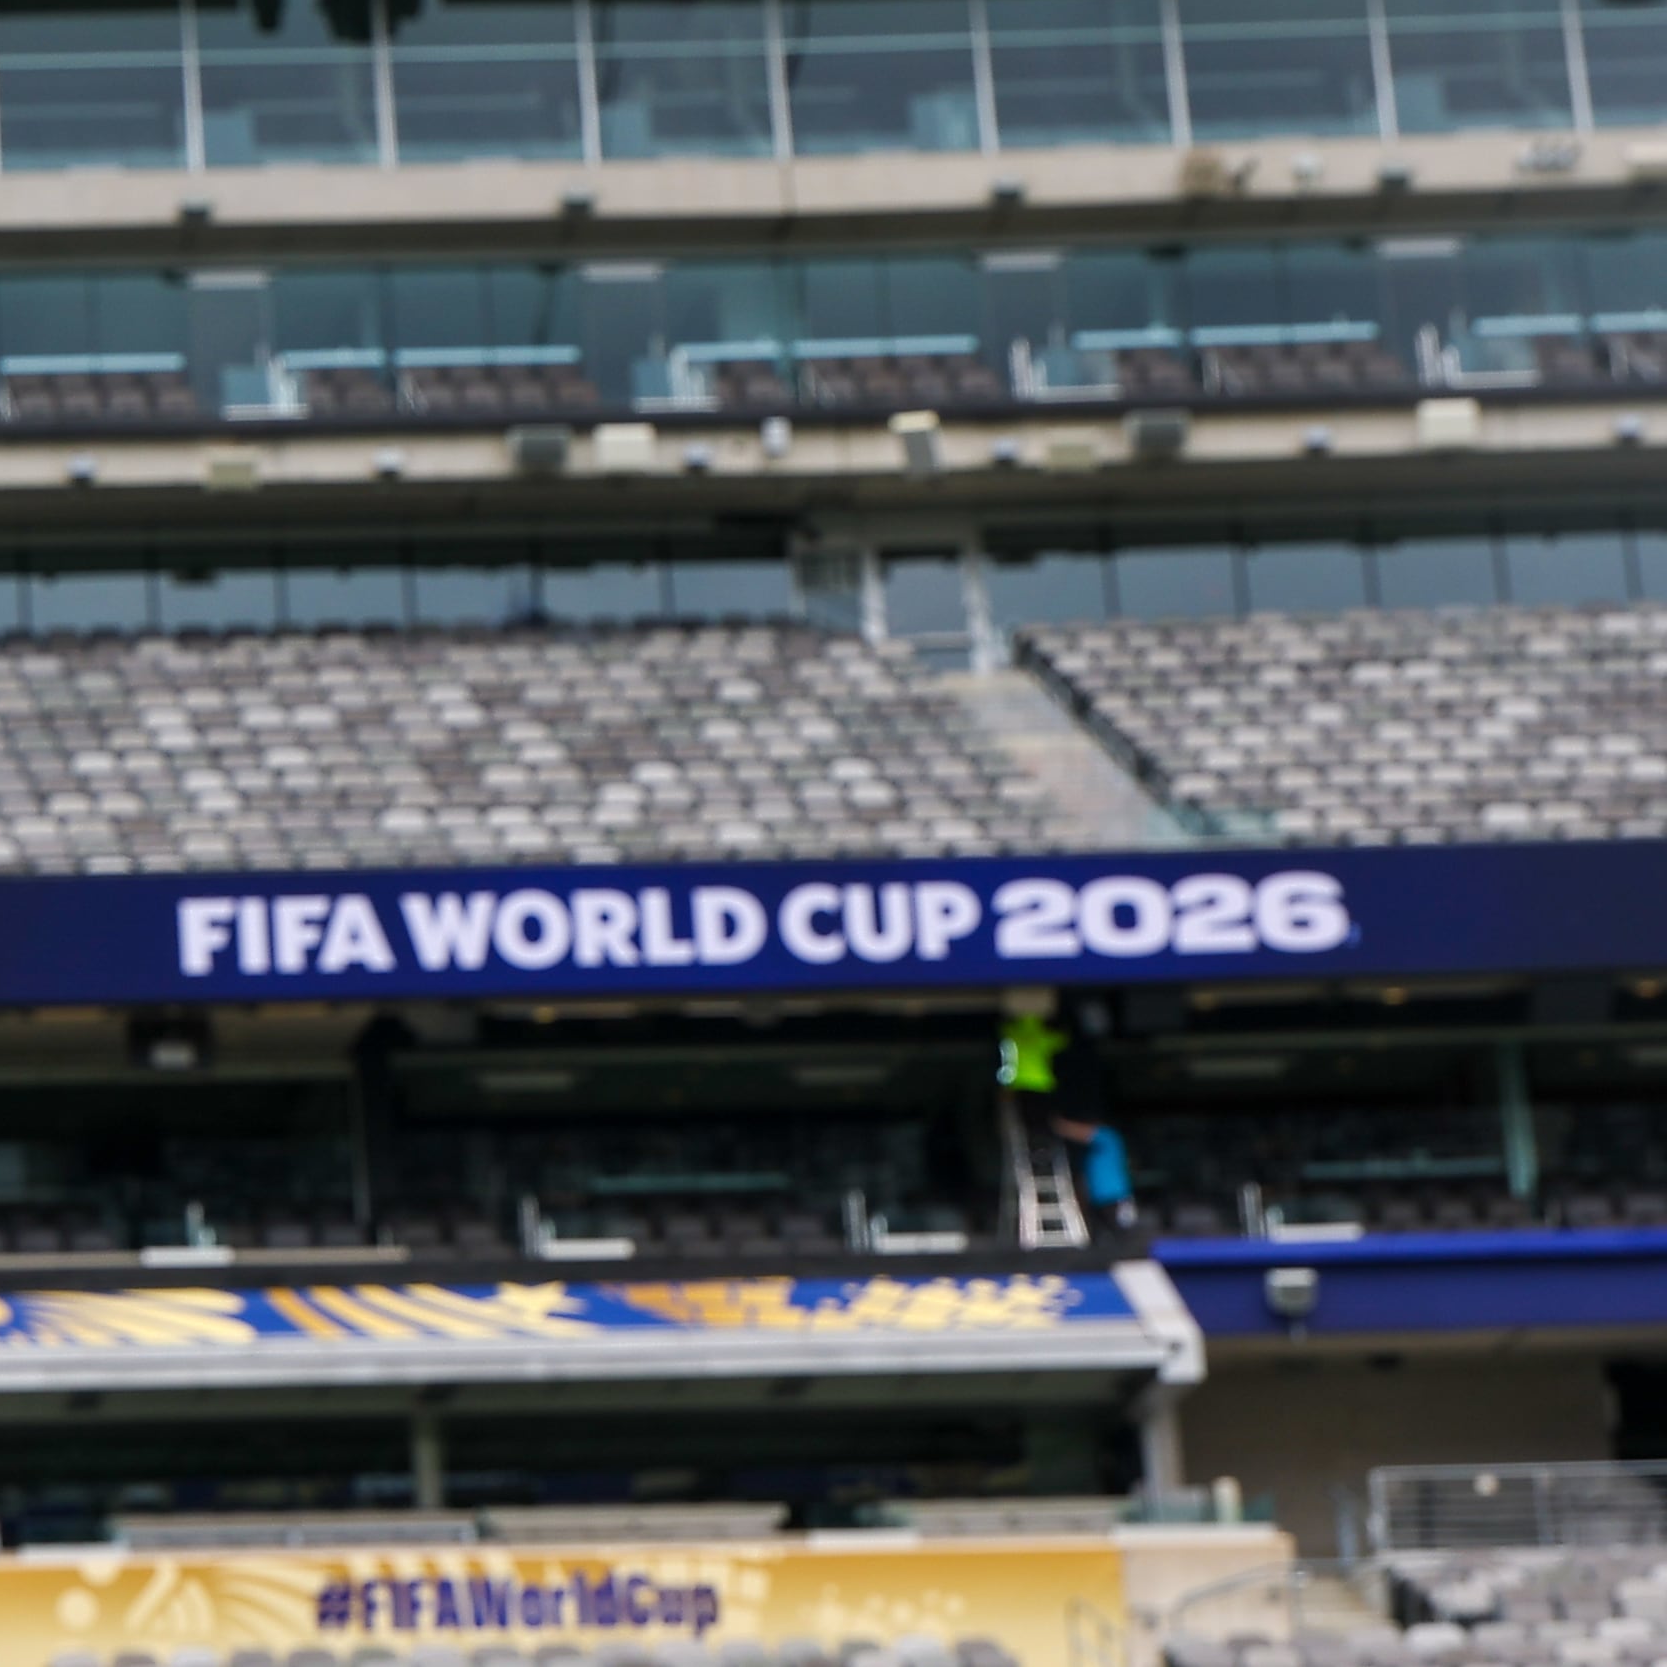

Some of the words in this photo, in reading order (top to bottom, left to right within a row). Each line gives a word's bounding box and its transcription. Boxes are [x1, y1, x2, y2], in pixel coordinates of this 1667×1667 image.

[175, 893, 398, 976] FIFA
[398, 886, 768, 972] WORLD
[776, 881, 983, 965] CUP
[991, 870, 1351, 959] 2026
[315, 1568, 720, 1642] #FIFAWorldCup
